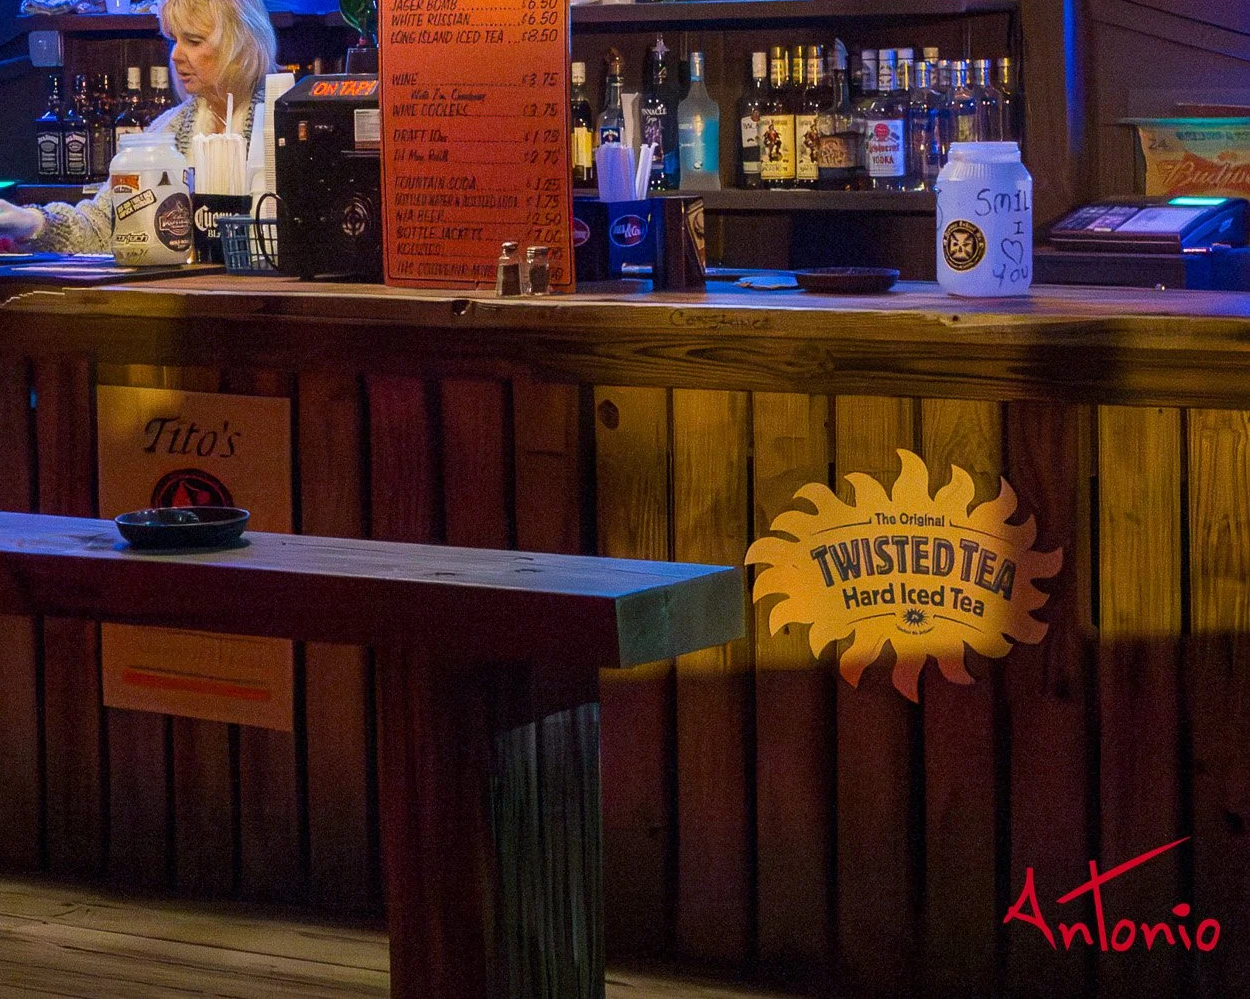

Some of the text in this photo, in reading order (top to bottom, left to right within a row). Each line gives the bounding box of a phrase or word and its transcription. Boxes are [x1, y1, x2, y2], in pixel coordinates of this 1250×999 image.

[391, 11, 558, 27] WHITE RUSSIAN $6.50
[390, 29, 558, 44] LONG ISLAND ICED TEA $8.50
[313, 80, 377, 96] ON TAP!
[143, 415, 243, 460] Tito's
[874, 512, 946, 528] The Original
[810, 535, 1018, 602] TWISTED TEA
[842, 582, 986, 618] Hard Iced Tea
